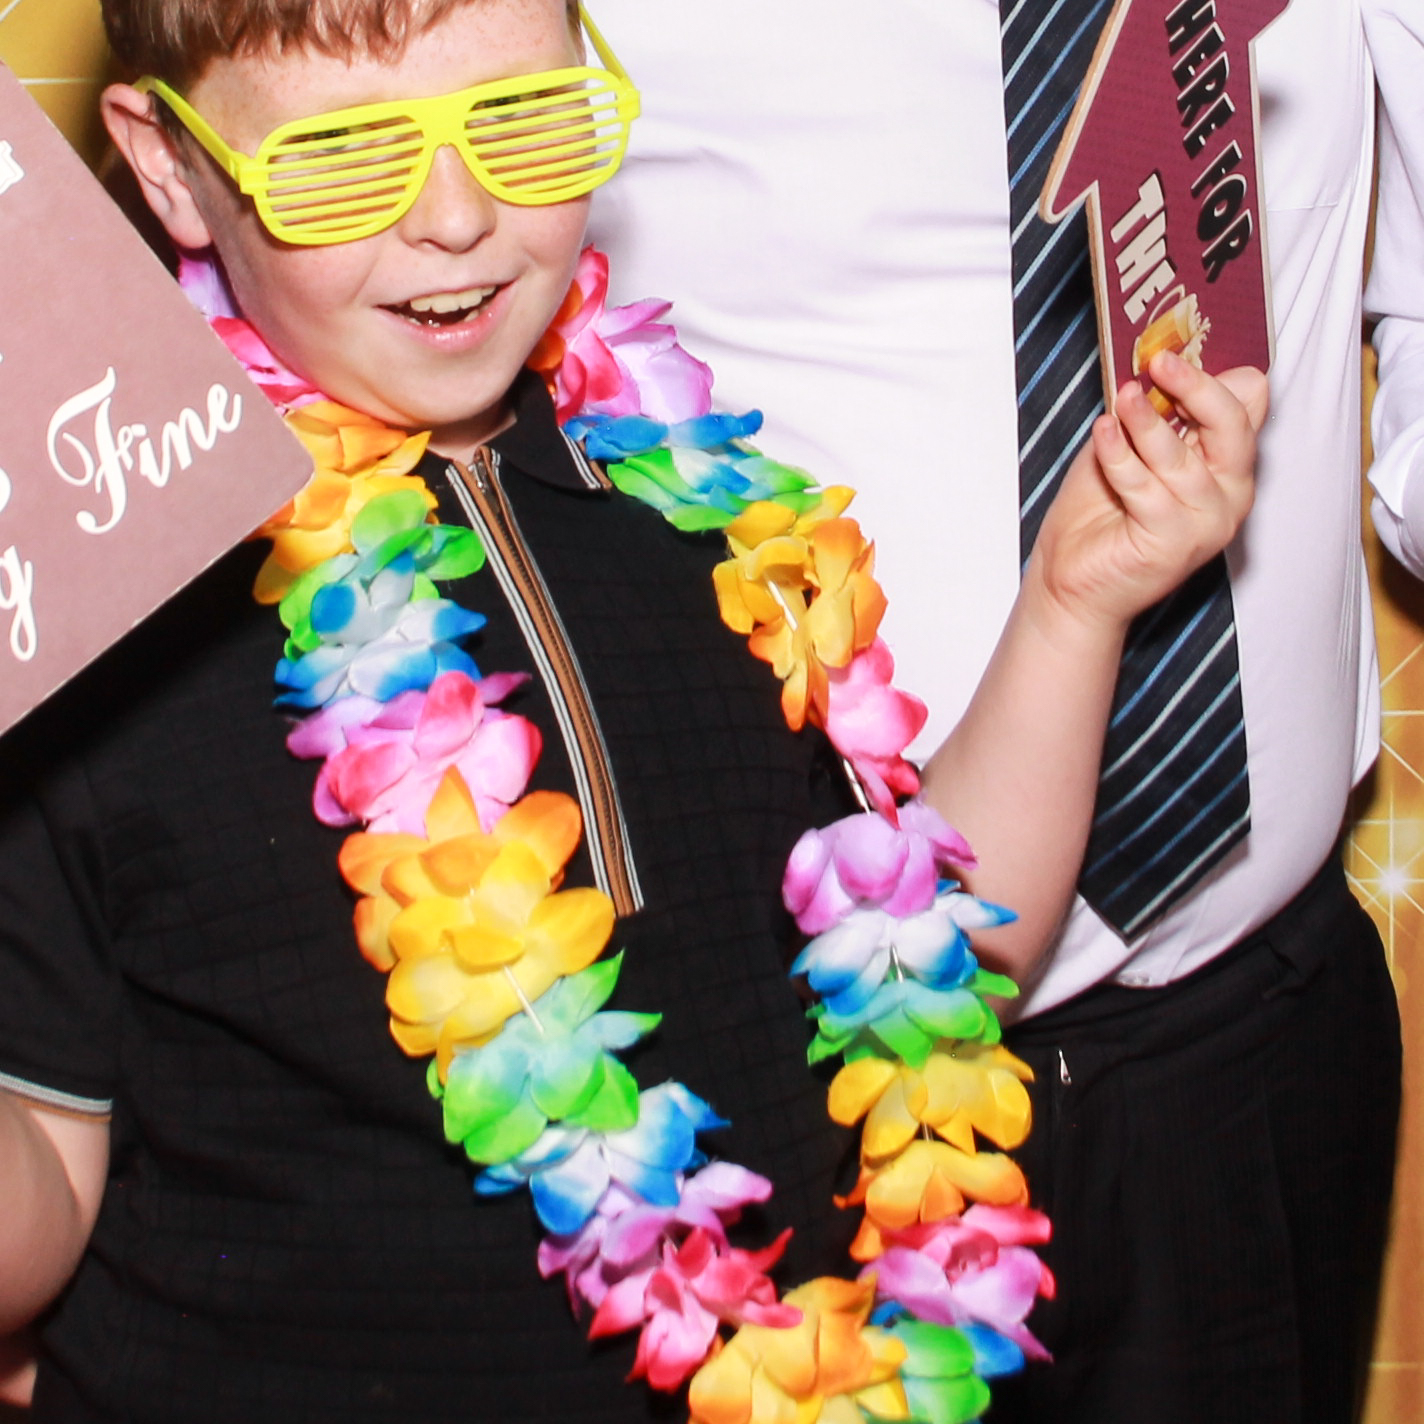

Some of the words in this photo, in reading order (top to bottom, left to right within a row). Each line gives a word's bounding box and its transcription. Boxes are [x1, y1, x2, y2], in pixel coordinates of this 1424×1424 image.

[1109, 173, 1178, 326] THE
[1190, 138, 1254, 283] FOR
[46, 366, 243, 536] Fine
